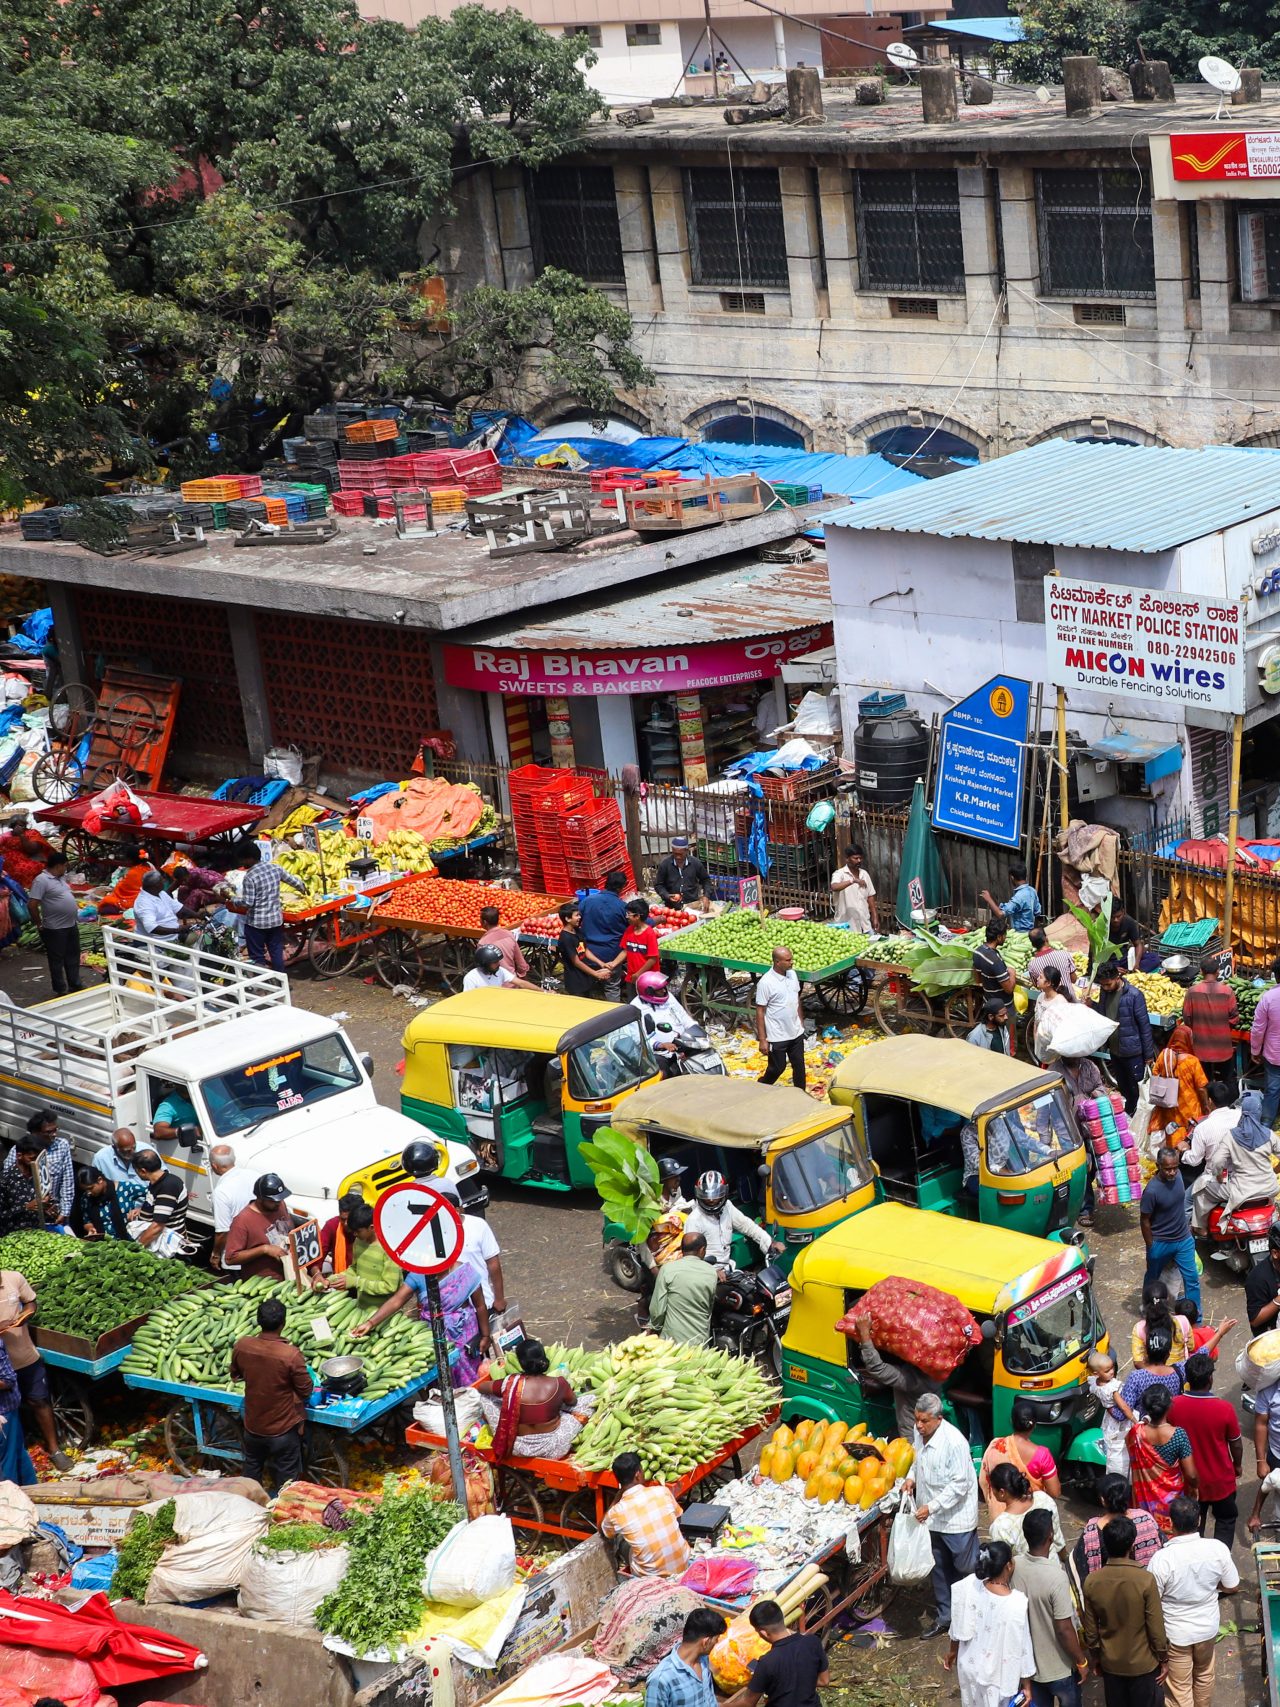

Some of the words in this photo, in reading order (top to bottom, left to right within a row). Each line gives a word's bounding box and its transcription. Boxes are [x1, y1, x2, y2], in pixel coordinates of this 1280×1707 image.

[1139, 594, 1199, 618] ಪೊಲೀಸ್
[1207, 604, 1239, 623] ಠಾಣೆ
[1050, 603, 1078, 622] CITY
[1081, 608, 1132, 630] MARKET
[1136, 615, 1181, 637] POLICE
[1185, 621, 1239, 645] STATION
[1057, 632, 1077, 643] HELP
[1079, 635, 1096, 646] LINE
[1098, 638, 1134, 651] NUMBER
[1147, 640, 1236, 665] 080-22942506
[473, 651, 530, 680] Raj
[542, 653, 689, 676] Bhavan
[1065, 648, 1145, 678] MICON
[1150, 659, 1226, 690] wires
[499, 679, 566, 694] SWEETS
[572, 682, 587, 694] &
[593, 679, 664, 693] BAKERY
[686, 675, 718, 688] PEACOCK
[719, 669, 763, 685] ENTERPRISES
[1077, 671, 1118, 688] Durable
[1121, 679, 1163, 697] Fencing
[1165, 685, 1212, 702] Solutions
[944, 774, 966, 786] Krishna
[967, 779, 992, 793] Rajendra
[993, 787, 1014, 799] Market
[955, 791, 1001, 812] K.R.Market
[976, 814, 1004, 828] Bengaluru
[358, 831, 372, 839] 40
[744, 888, 758, 903] 60
[277, 1093, 304, 1110] M.P.S
[297, 1243, 320, 1265] 20
